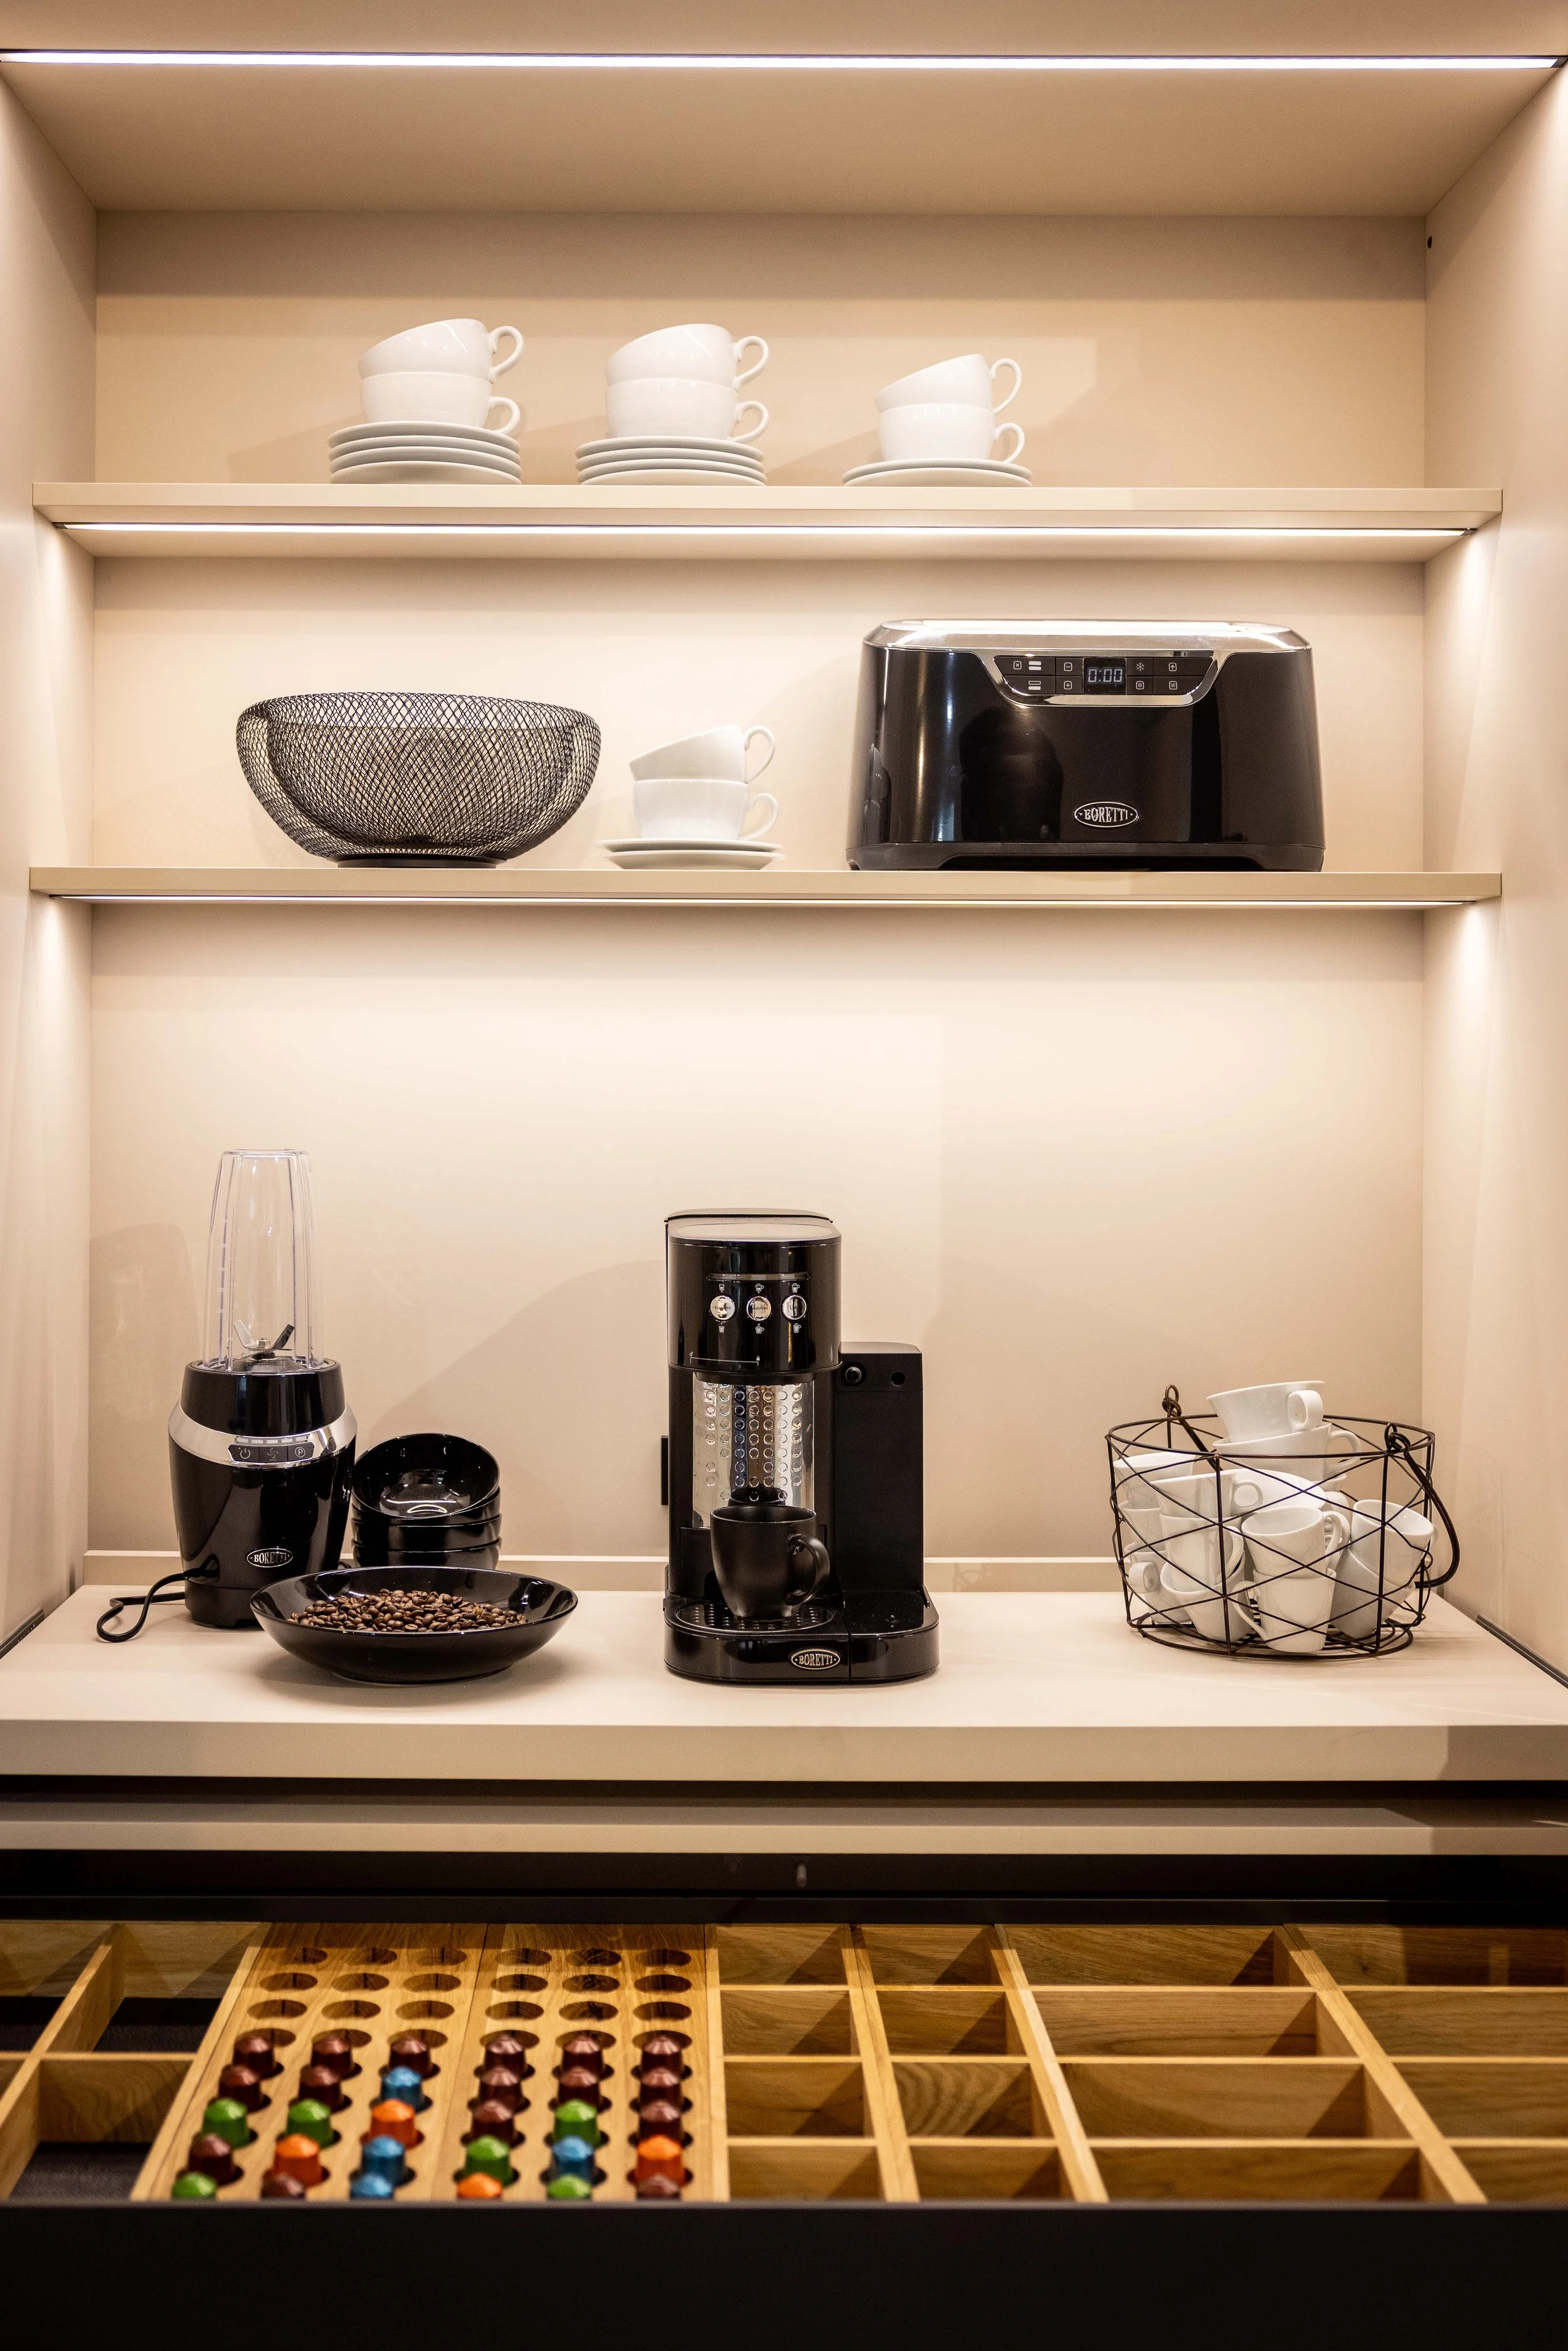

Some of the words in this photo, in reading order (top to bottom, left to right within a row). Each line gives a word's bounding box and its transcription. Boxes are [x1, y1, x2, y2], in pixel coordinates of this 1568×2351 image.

[1087, 669, 1123, 682] 0:00
[1084, 807, 1128, 822] BORETTI
[253, 1552, 287, 1564] BORETTI
[798, 1653, 833, 1666] BORETTI
